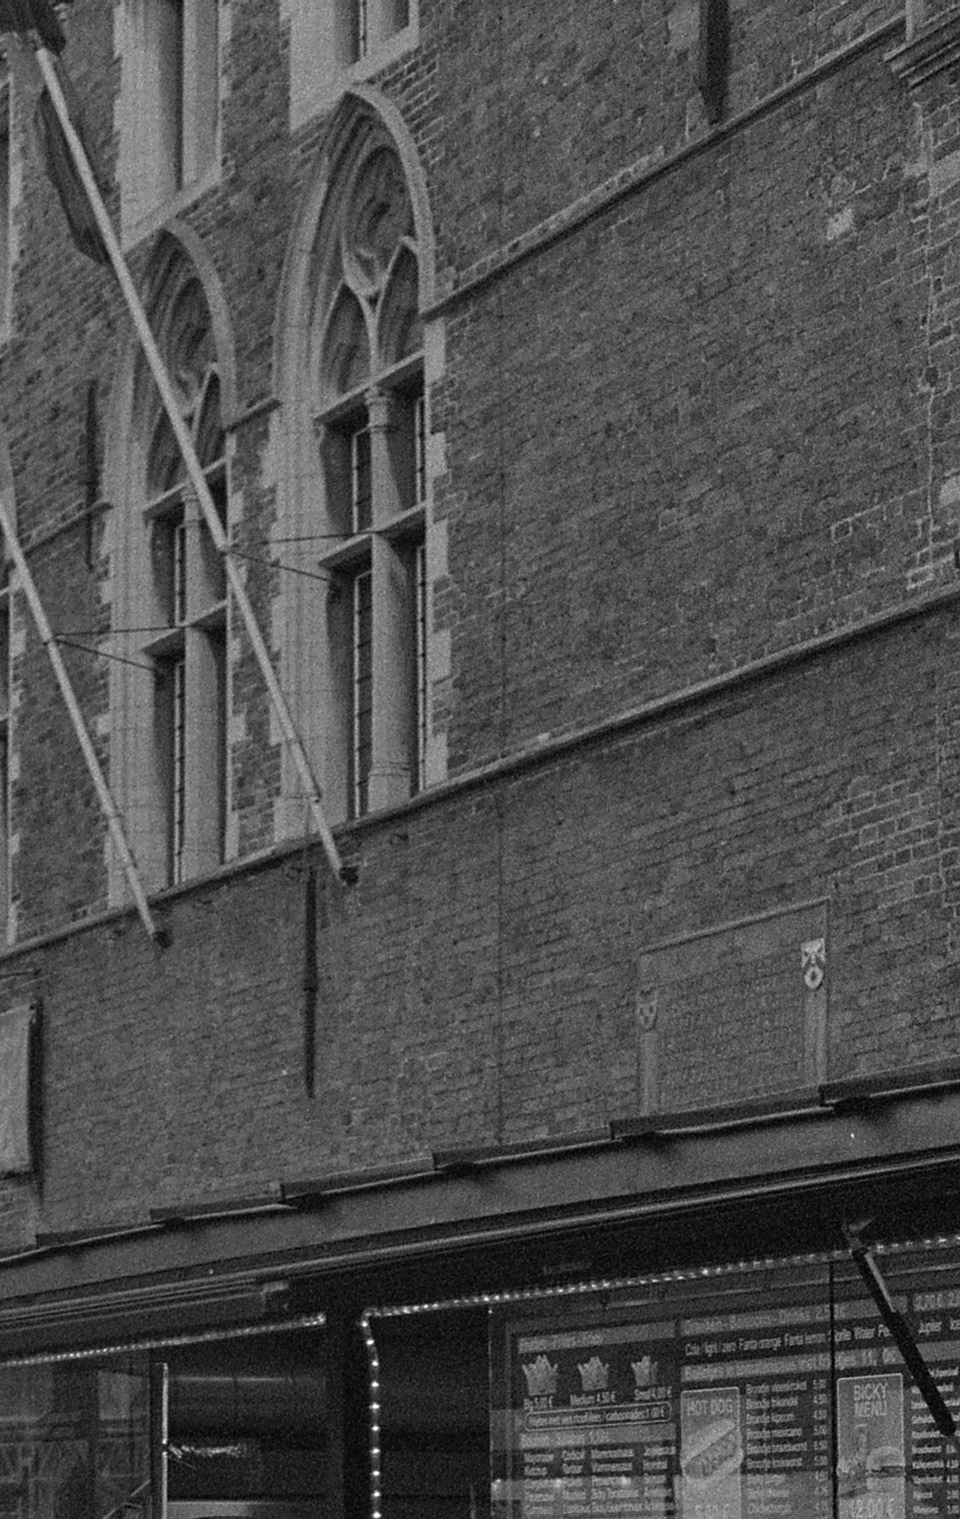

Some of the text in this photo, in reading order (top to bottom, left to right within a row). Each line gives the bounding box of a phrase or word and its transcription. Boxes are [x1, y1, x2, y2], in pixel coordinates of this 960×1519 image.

[853, 1382, 888, 1402] BICKY
[686, 1398, 734, 1417] HOT DOG
[854, 1400, 888, 1418] MENU
